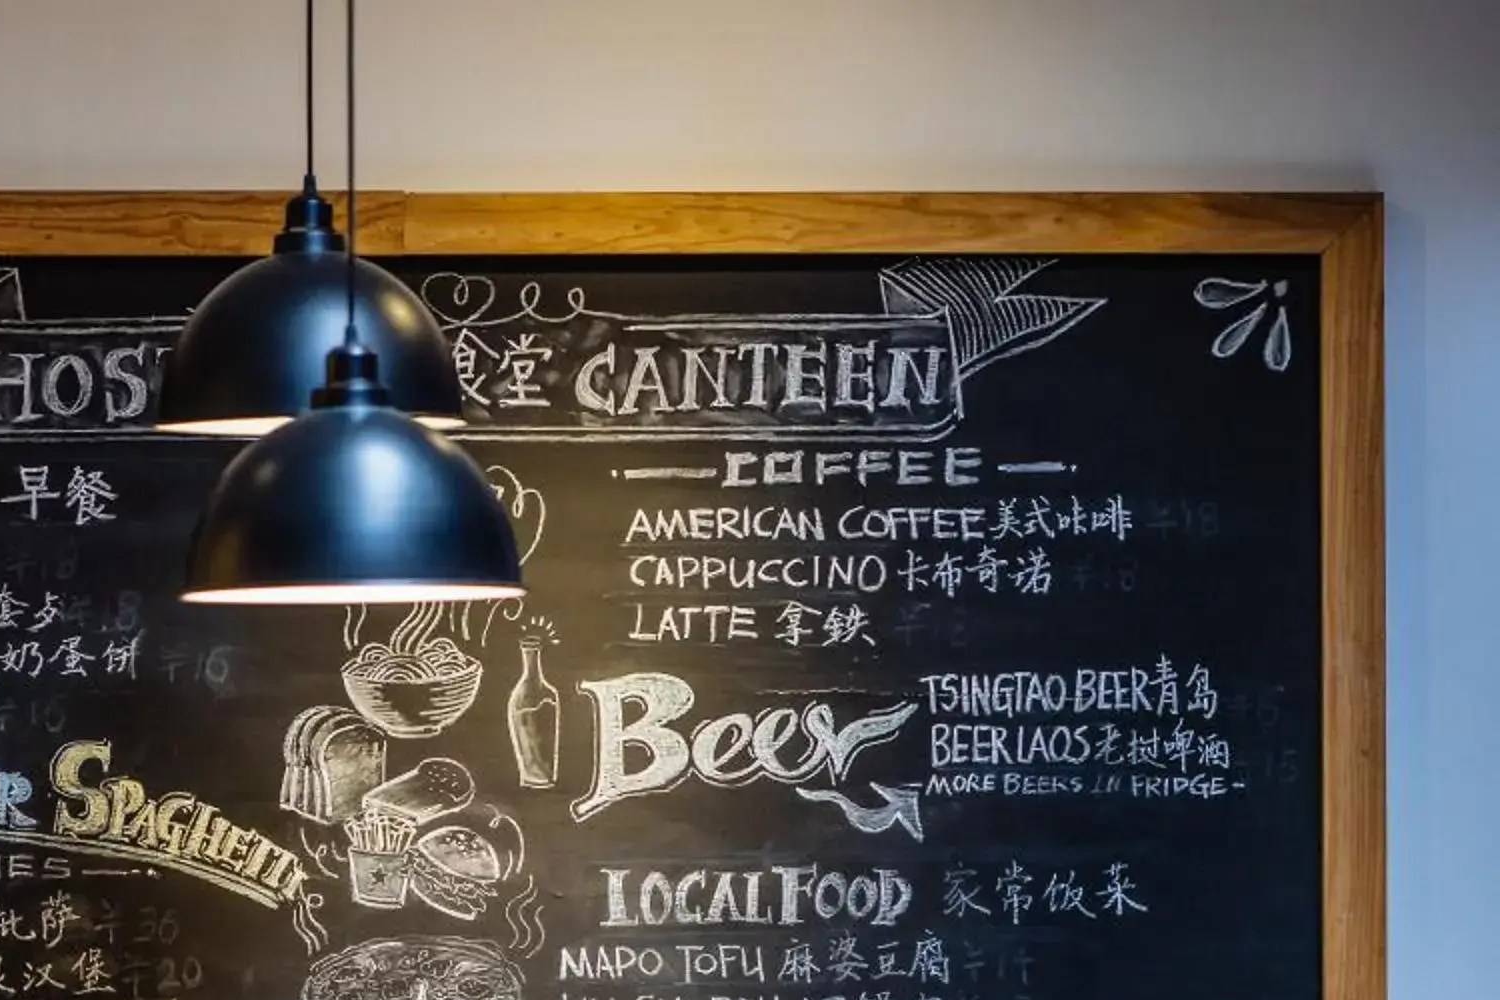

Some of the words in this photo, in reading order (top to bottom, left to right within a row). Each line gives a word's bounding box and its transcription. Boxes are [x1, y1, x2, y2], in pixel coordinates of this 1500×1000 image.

[573, 340, 946, 416] CANTEEN
[0, 464, 119, 525] 早餐
[721, 448, 982, 488] COFFEE
[625, 505, 826, 542] AMERICAN
[837, 505, 986, 541] COFFEE
[629, 554, 887, 592] CAPPUCCINO
[897, 544, 1052, 600] 卡布奇诺
[629, 603, 759, 642] LATTE
[919, 672, 1066, 718] TSINGTAO
[1073, 667, 1153, 714] BEER
[1149, 651, 1218, 719] 青岛
[925, 775, 996, 796] MORE
[1003, 775, 1085, 797] BEERS
[942, 860, 1149, 926] 家常饭菜
[559, 947, 664, 981] MAPO
[675, 945, 766, 984] TOFU
[778, 929, 950, 985] 麻婆豆腐
